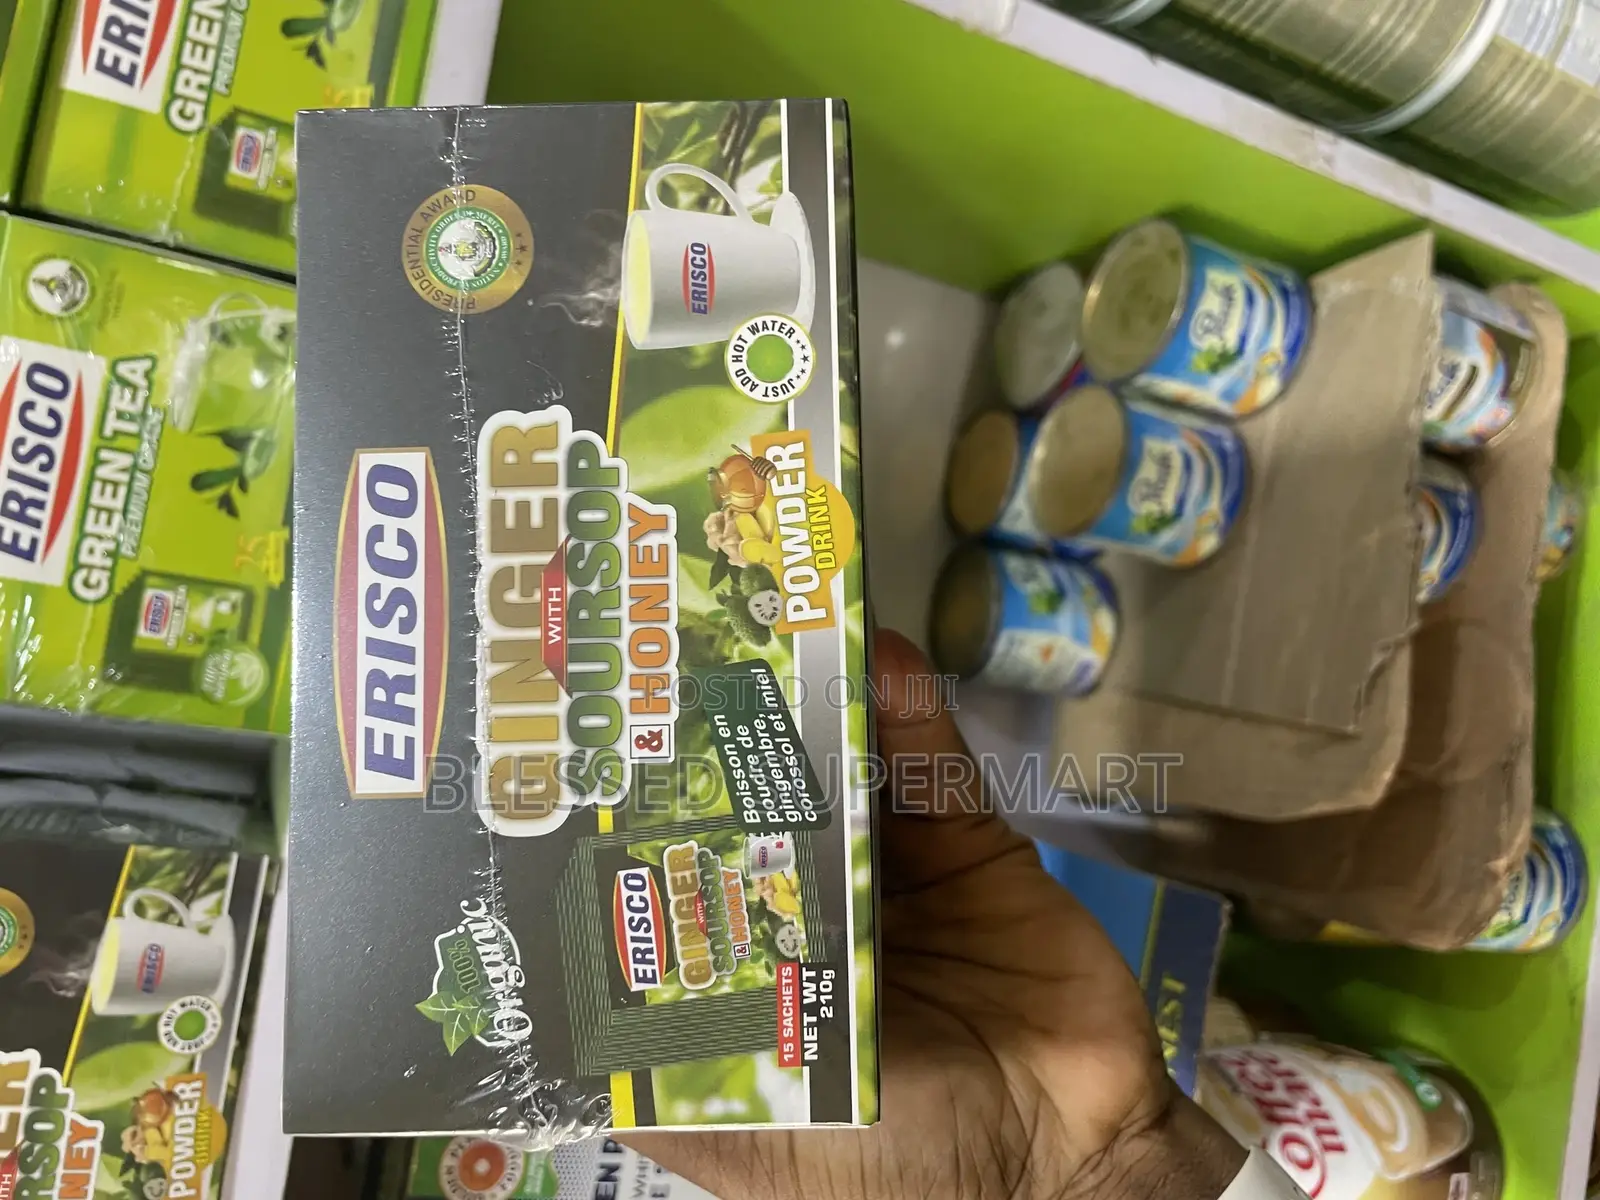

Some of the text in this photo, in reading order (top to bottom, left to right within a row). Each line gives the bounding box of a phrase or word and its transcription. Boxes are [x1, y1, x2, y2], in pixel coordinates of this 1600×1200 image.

[406, 228, 476, 310] PRESIDENTIAL
[690, 242, 708, 315] ERISCO
[731, 319, 796, 398] JUST ADD HOT WATER
[0, 362, 71, 563] ERISCO
[71, 447, 134, 601] GREEN
[103, 357, 153, 438] TEA
[122, 471, 151, 558] PREMIUM
[764, 440, 828, 624] POWDER
[805, 485, 837, 572] DRINK
[364, 463, 419, 781] ERISCO
[488, 420, 560, 821] GINGER
[548, 586, 562, 645] WITH
[565, 439, 623, 799] SOURSOP
[629, 503, 670, 753] & HONEY
[713, 714, 762, 824] Boisson en
[736, 724, 784, 823] poudre de
[750, 668, 818, 822] corossol et miel
[753, 713, 803, 823] gingembre,
[446, 938, 482, 994] 100%
[622, 872, 658, 985] ERISCO
[667, 845, 712, 986] GINGER
[695, 902, 705, 924] WITH
[697, 851, 735, 974] SOURSOP
[722, 870, 749, 956] & HONEY
[457, 897, 534, 1041] Organic
[781, 965, 793, 1062] 15 SACHETS
[801, 966, 818, 1061] NET WT
[819, 968, 836, 1018] 210g
[168, 1078, 203, 1200] POWDER
